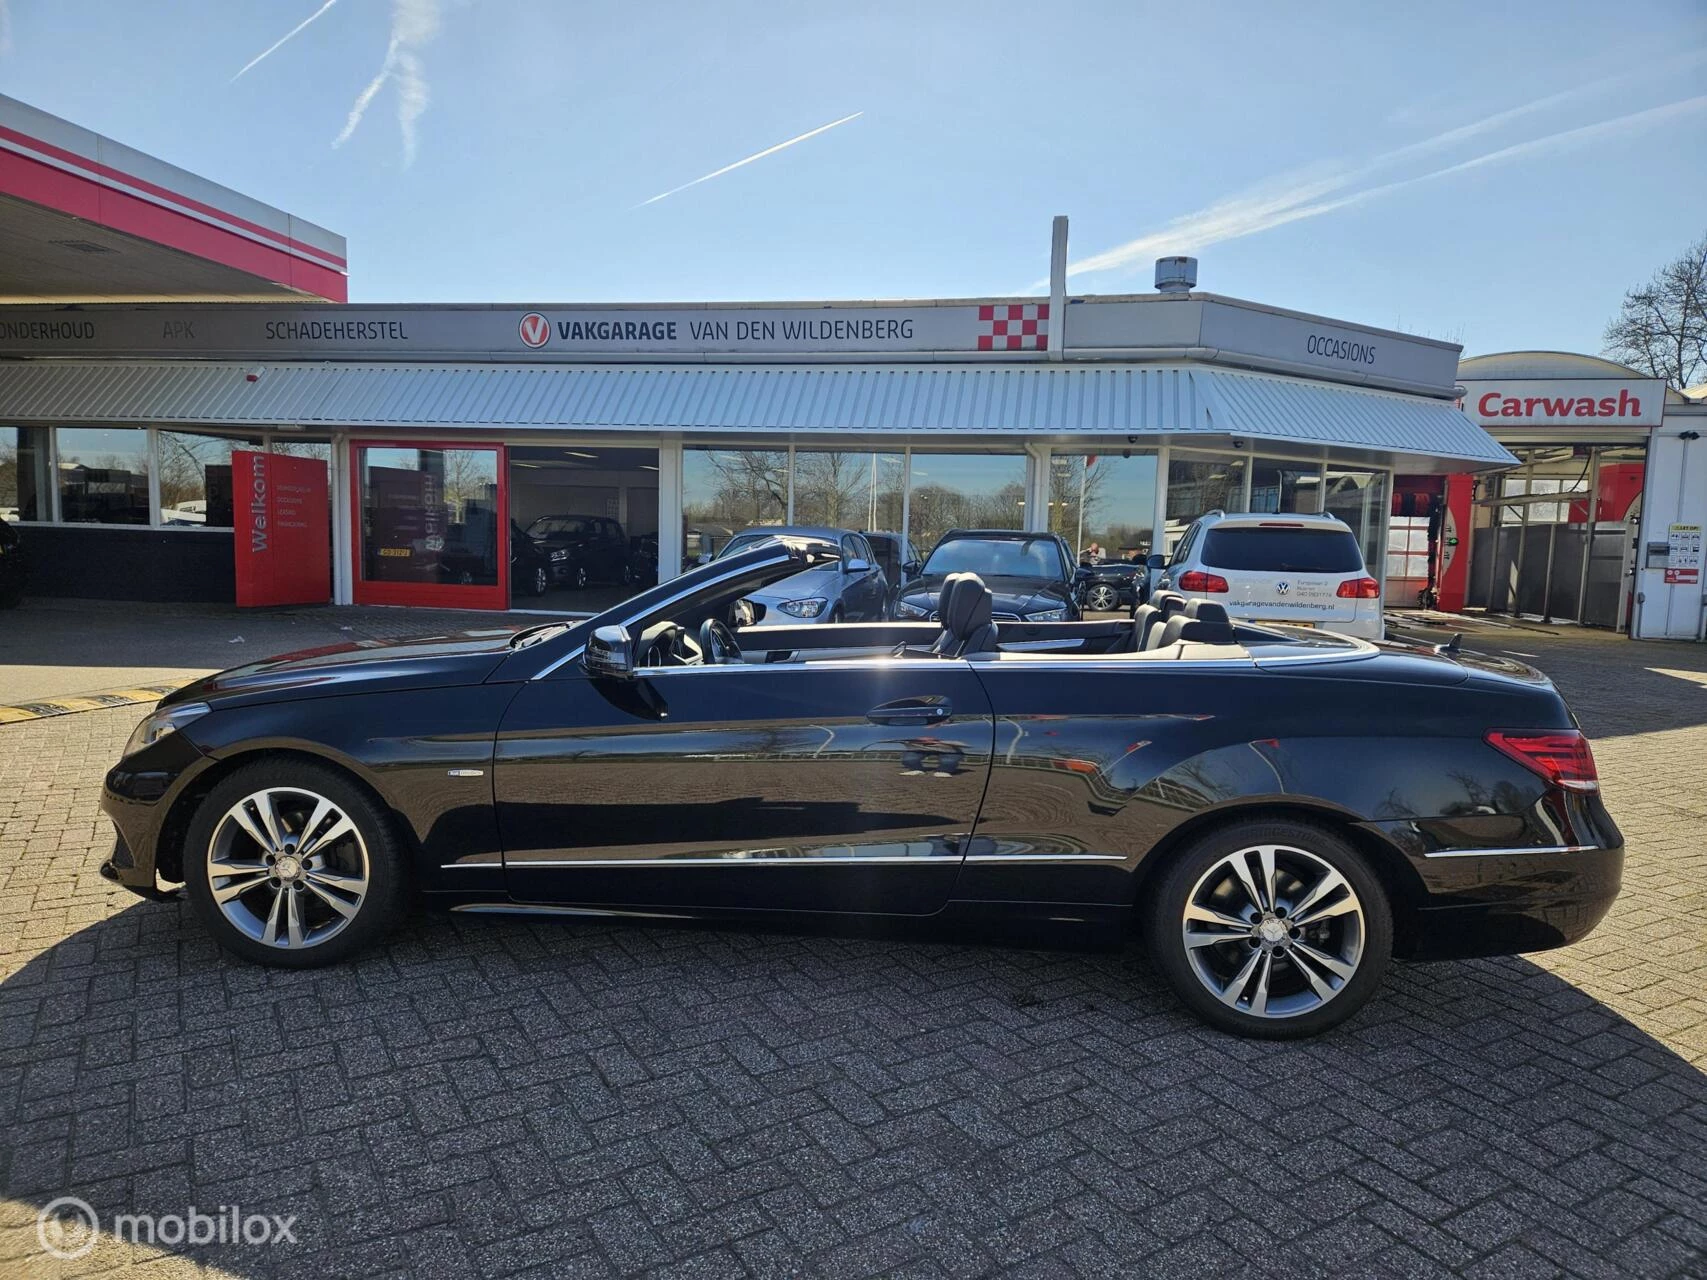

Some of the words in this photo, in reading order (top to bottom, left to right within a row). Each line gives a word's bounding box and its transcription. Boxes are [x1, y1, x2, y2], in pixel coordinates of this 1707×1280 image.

[0, 321, 95, 339] ONDERHOUD
[163, 321, 195, 338] APK
[265, 321, 408, 340] SCHADEHERSTEL
[557, 321, 677, 340] VAKGARAGE
[690, 321, 728, 340] VAN
[737, 321, 775, 340] DEN
[782, 319, 914, 340] WILDENBERG
[1307, 335, 1376, 365] OCCASIONS
[1478, 388, 1642, 417] Carwash
[251, 456, 267, 552] Welkom
